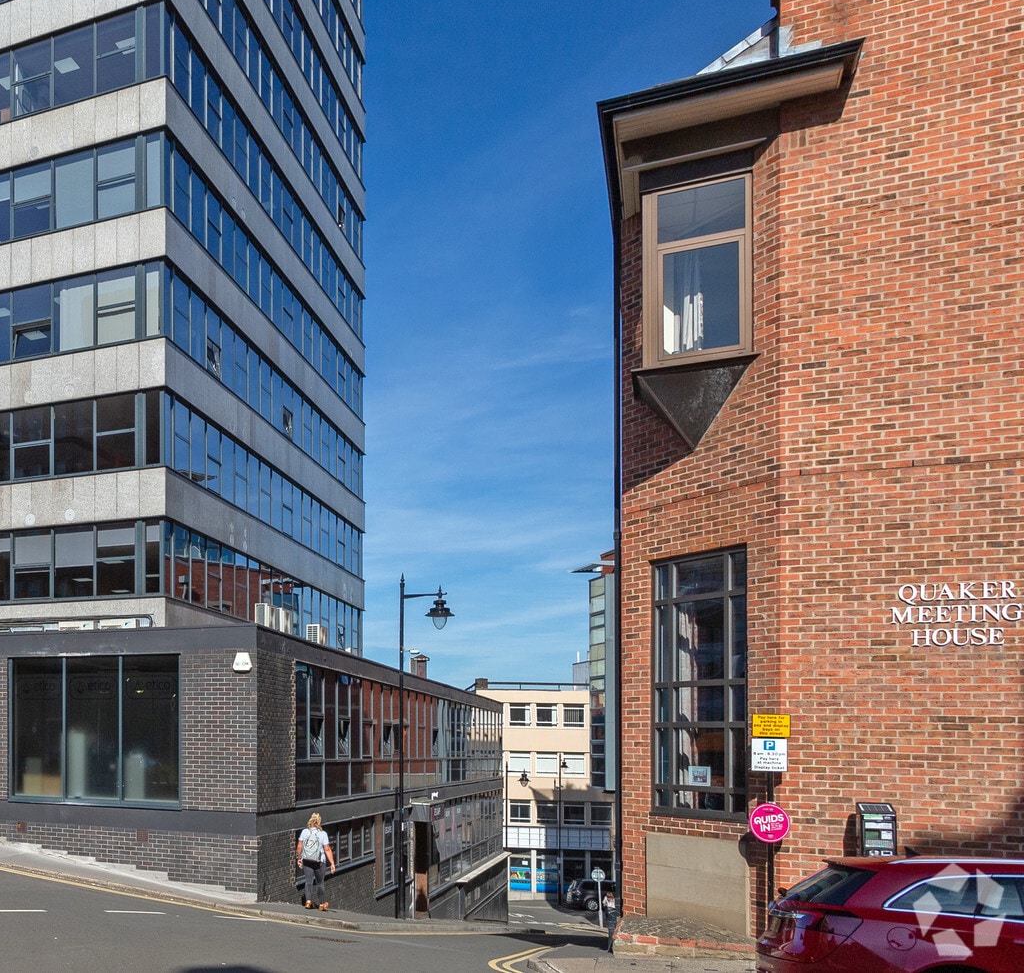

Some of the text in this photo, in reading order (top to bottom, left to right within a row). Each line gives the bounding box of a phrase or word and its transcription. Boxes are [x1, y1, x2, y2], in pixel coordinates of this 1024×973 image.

[898, 580, 1016, 606] QUAKER
[890, 603, 1024, 624] MEETING
[911, 627, 1006, 647] HOUSE
[753, 813, 784, 825] QUIDS
[760, 823, 771, 832] IN
